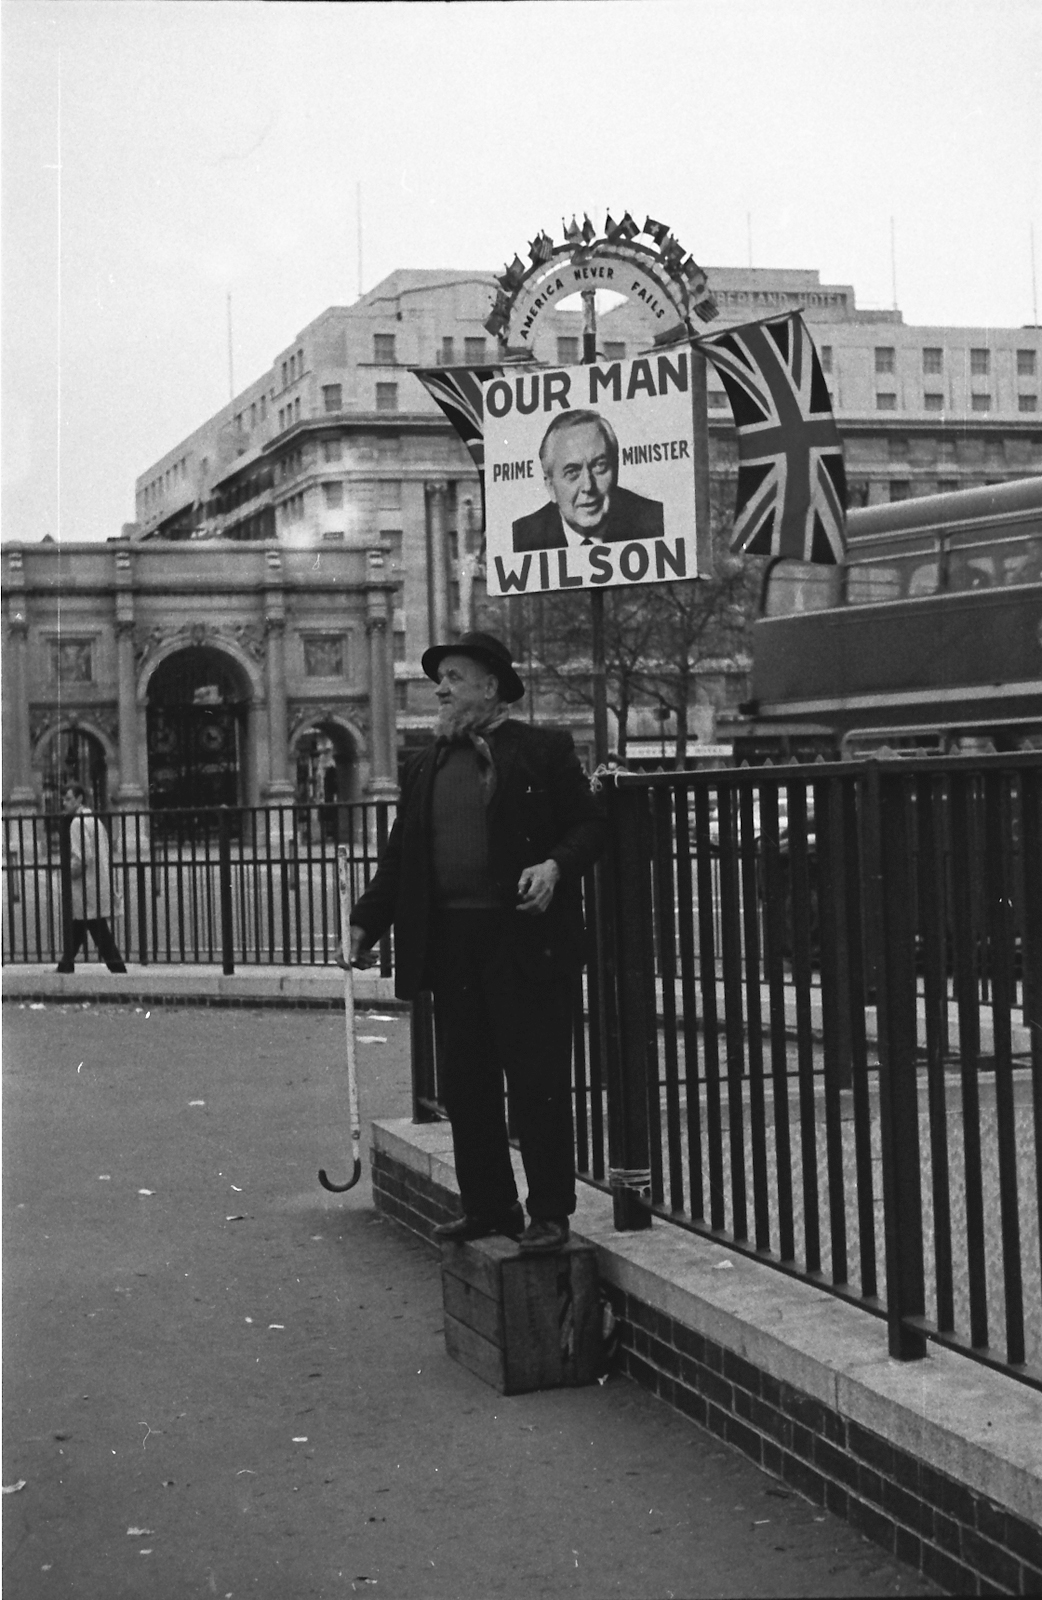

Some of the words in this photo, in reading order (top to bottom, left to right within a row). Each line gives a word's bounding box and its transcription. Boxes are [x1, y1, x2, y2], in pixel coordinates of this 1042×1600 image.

[519, 277, 565, 341] AMERICA
[573, 265, 615, 282] NEVER
[630, 280, 666, 319] FAILS
[798, 291, 845, 306] HOTEL
[485, 370, 572, 419] OUR
[587, 352, 689, 404] MAN
[492, 459, 535, 483] PRIME
[622, 439, 691, 466] MINISTER
[493, 537, 688, 593] WILSON
